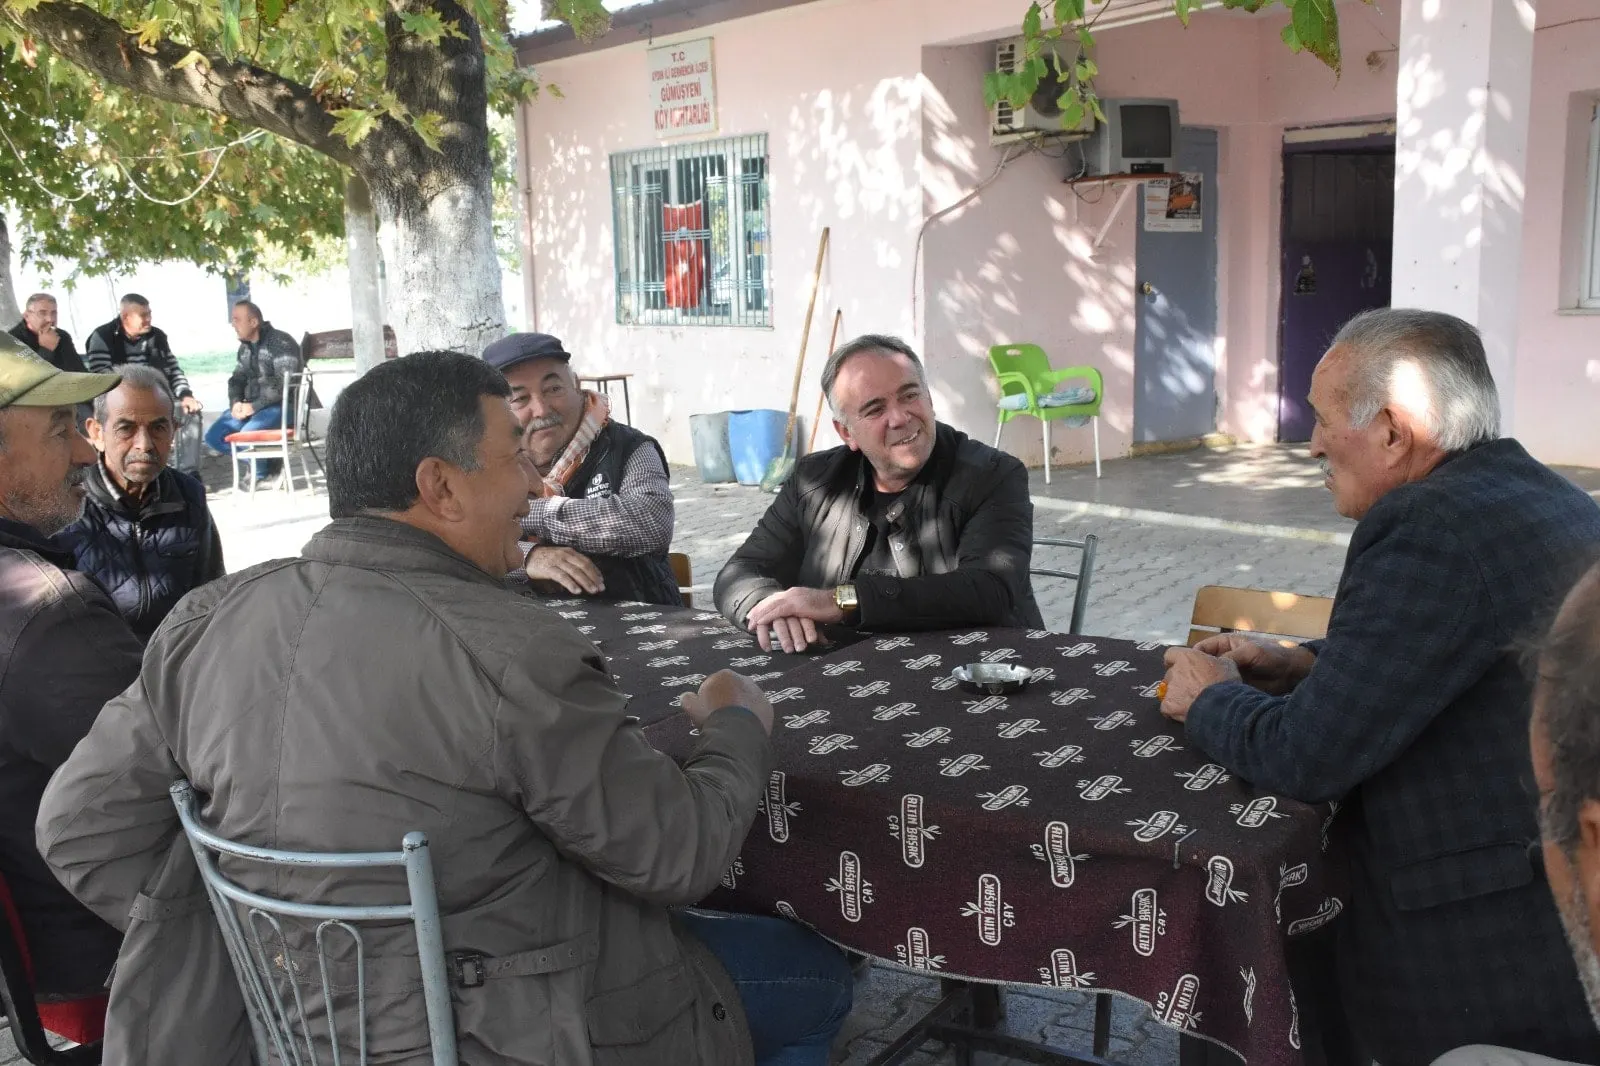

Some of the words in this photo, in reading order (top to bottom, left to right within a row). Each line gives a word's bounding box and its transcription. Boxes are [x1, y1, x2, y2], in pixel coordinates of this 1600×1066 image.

[655, 104, 669, 130] KÖY
[907, 796, 918, 827] ALTIN
[887, 815, 900, 840] ÇAY
[1051, 826, 1064, 855] ALTIN
[906, 827, 919, 859] BAŞAK
[845, 860, 857, 892] BAŞAK
[862, 879, 874, 904] ÇAY
[984, 883, 997, 914] BAŞAK
[845, 893, 857, 917] ALTIN
[1003, 902, 1015, 927] ÇAY
[984, 916, 995, 942] ALTIN
[1139, 923, 1150, 950] ALTIN
[894, 944, 907, 965] ÇAY
[912, 931, 925, 955] ALTIN
[1057, 953, 1070, 973] ALTIN
[1177, 980, 1195, 1010] ALTIN
